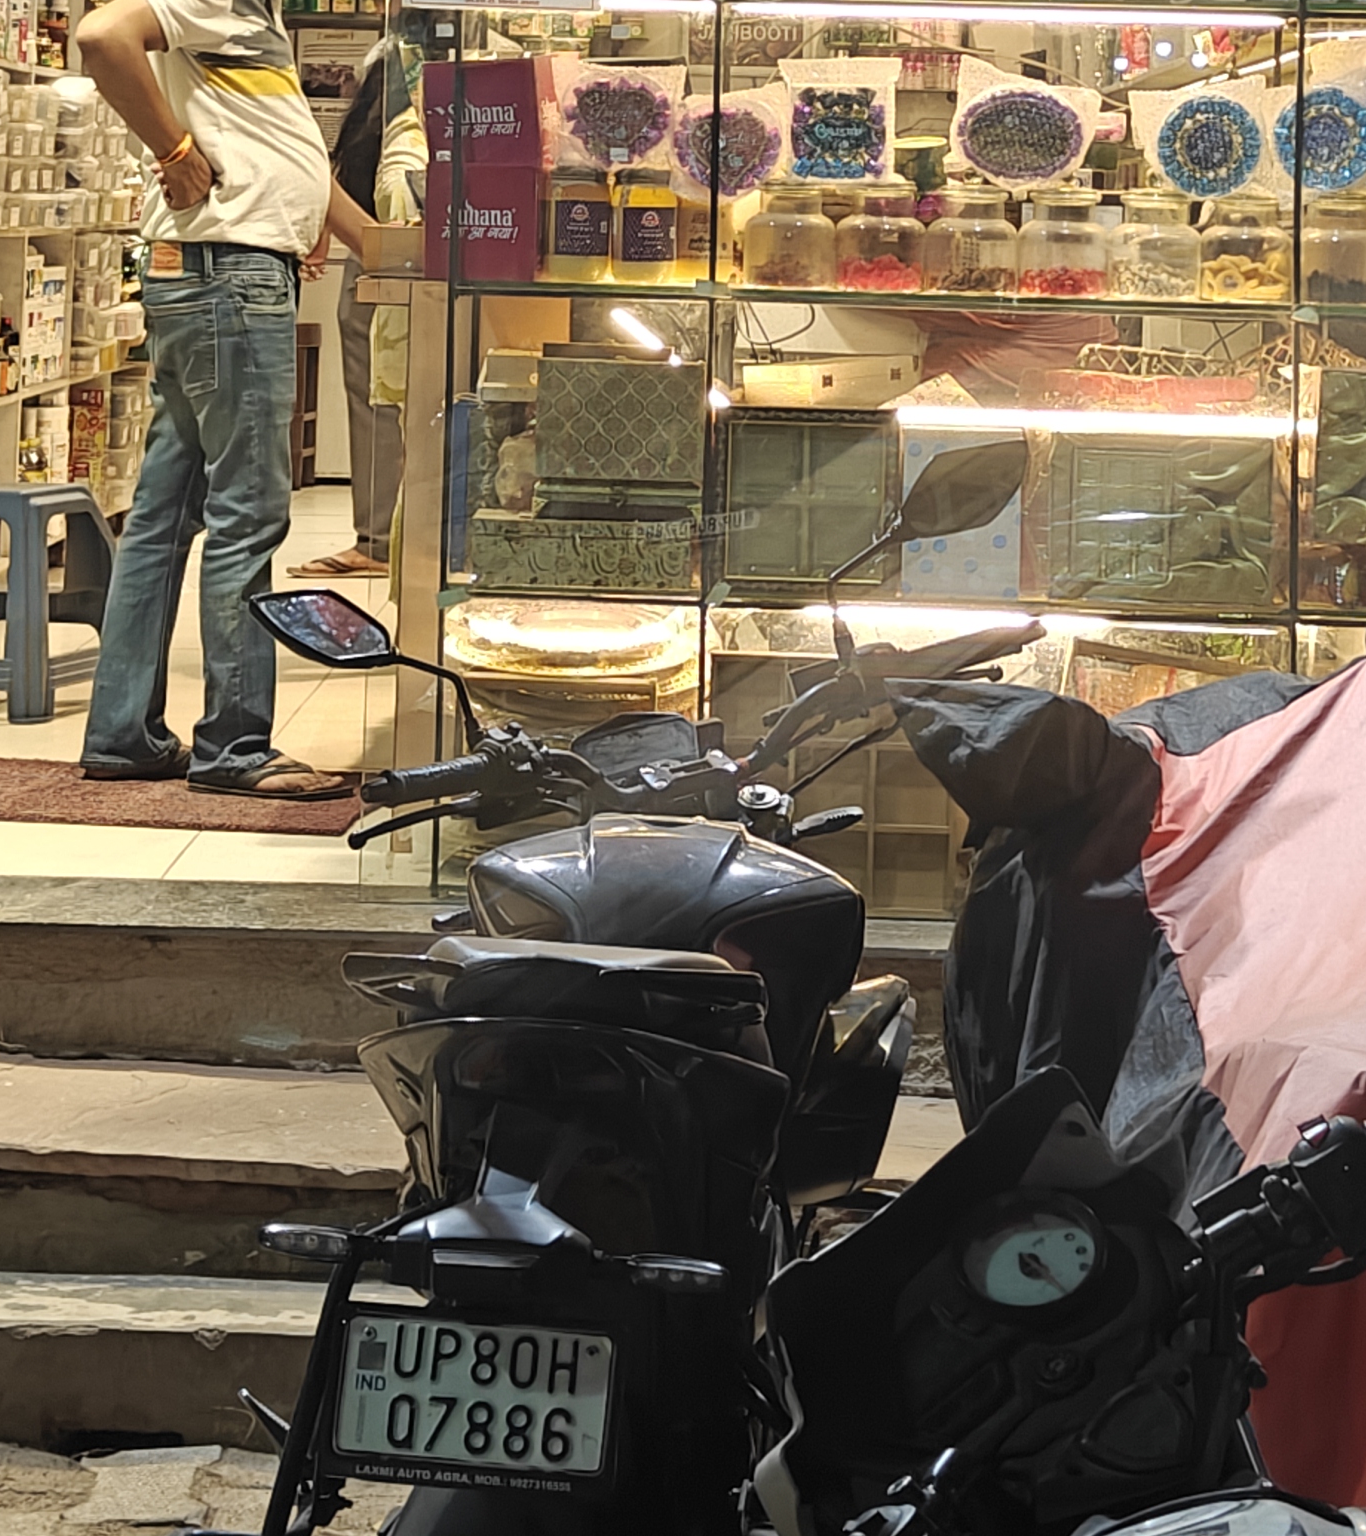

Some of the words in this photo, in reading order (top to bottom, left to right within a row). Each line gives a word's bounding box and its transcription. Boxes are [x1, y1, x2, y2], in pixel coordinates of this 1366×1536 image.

[393, 1323, 580, 1395] UP80H
[355, 1372, 386, 1391] IND
[355, 1464, 394, 1478] LAXMI
[397, 1467, 431, 1480] AUTO
